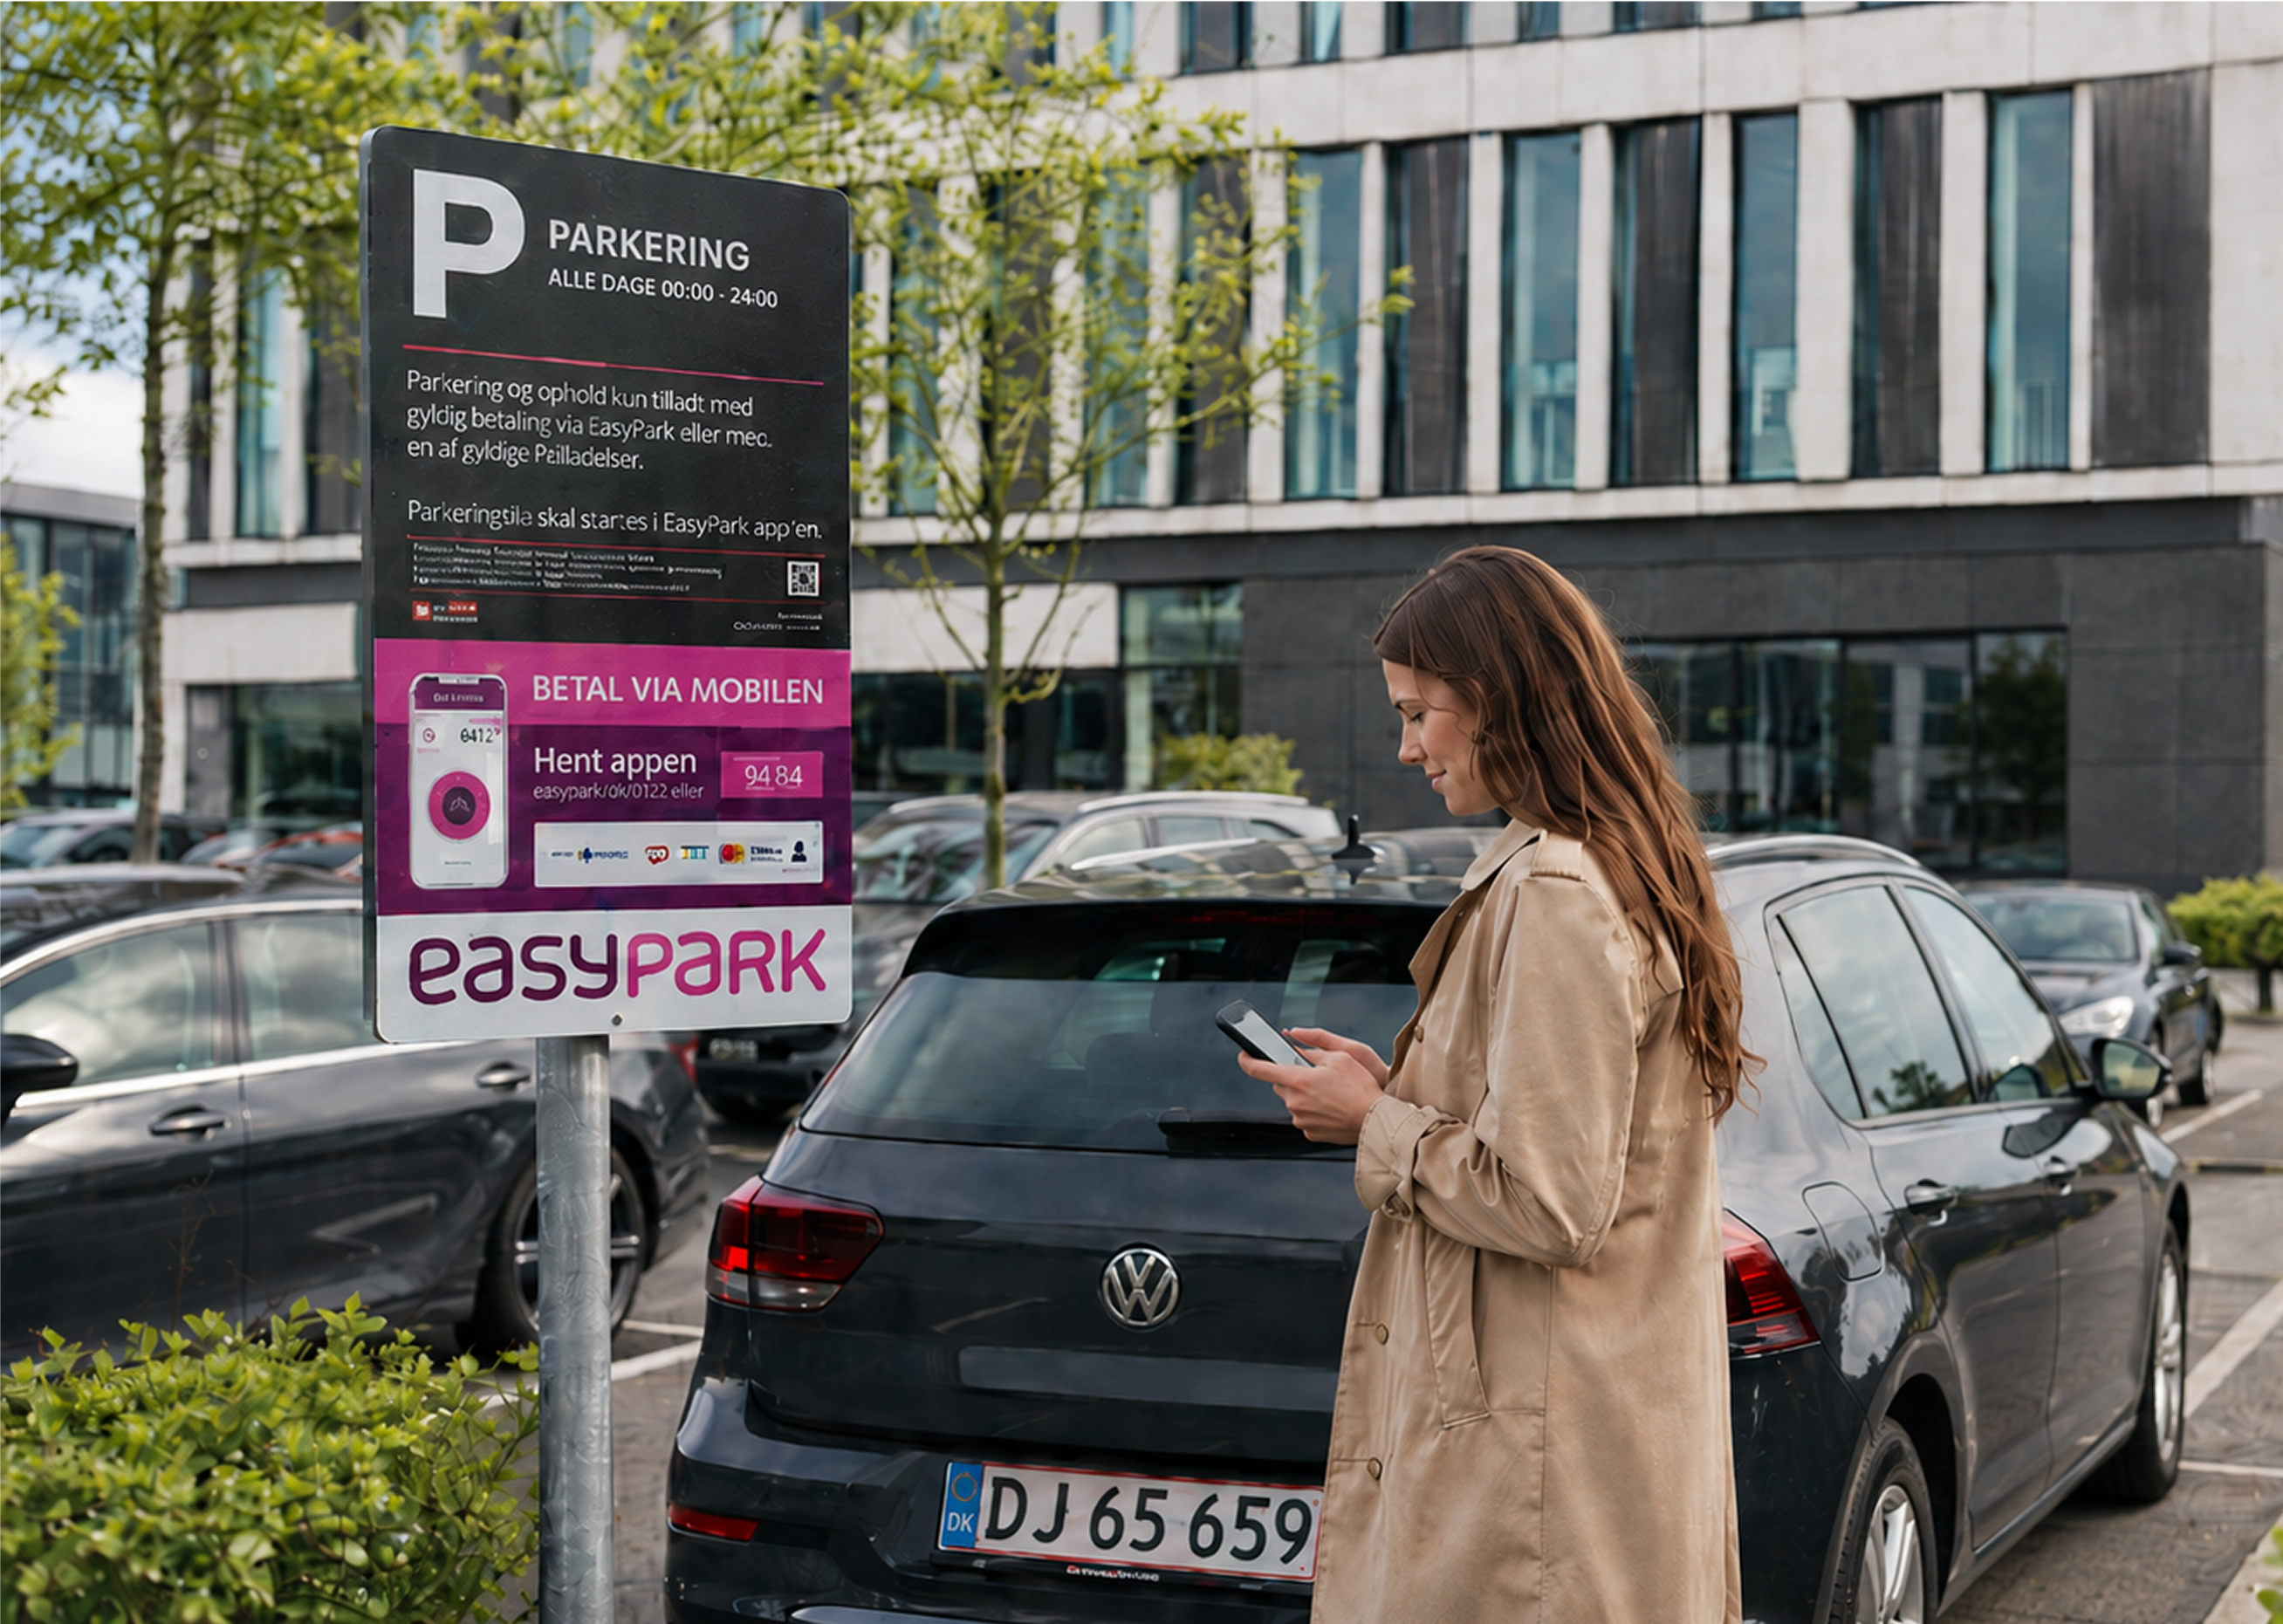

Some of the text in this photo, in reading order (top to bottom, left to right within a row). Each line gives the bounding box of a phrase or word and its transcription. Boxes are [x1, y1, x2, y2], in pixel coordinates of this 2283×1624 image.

[414, 168, 525, 319] P
[549, 220, 750, 271] PARKERING
[548, 268, 596, 290] ALLE
[602, 273, 655, 296] DAGE
[662, 280, 714, 301] 00:00
[730, 287, 778, 308] 24:00
[408, 370, 753, 416] Parkering og ophold kun tilladt med
[407, 404, 467, 430] gyldig
[471, 408, 552, 438] betaling
[556, 415, 583, 435] via
[590, 417, 675, 442] EasyPark
[680, 425, 721, 444] eller
[408, 442, 433, 457] en
[438, 438, 457, 458] af
[462, 442, 530, 468] gyldige
[538, 506, 575, 529] skal
[653, 512, 657, 531] i
[663, 512, 749, 538] EasyPark
[533, 675, 823, 704] BETAL VIA MOBILEN
[535, 747, 697, 780] Hent appen
[745, 765, 803, 786] 94 84
[671, 784, 704, 798] eller
[1107, 1252, 1174, 1325] VW
[947, 1512, 973, 1533] DK
[984, 1477, 1313, 1565] DJ 65 659
